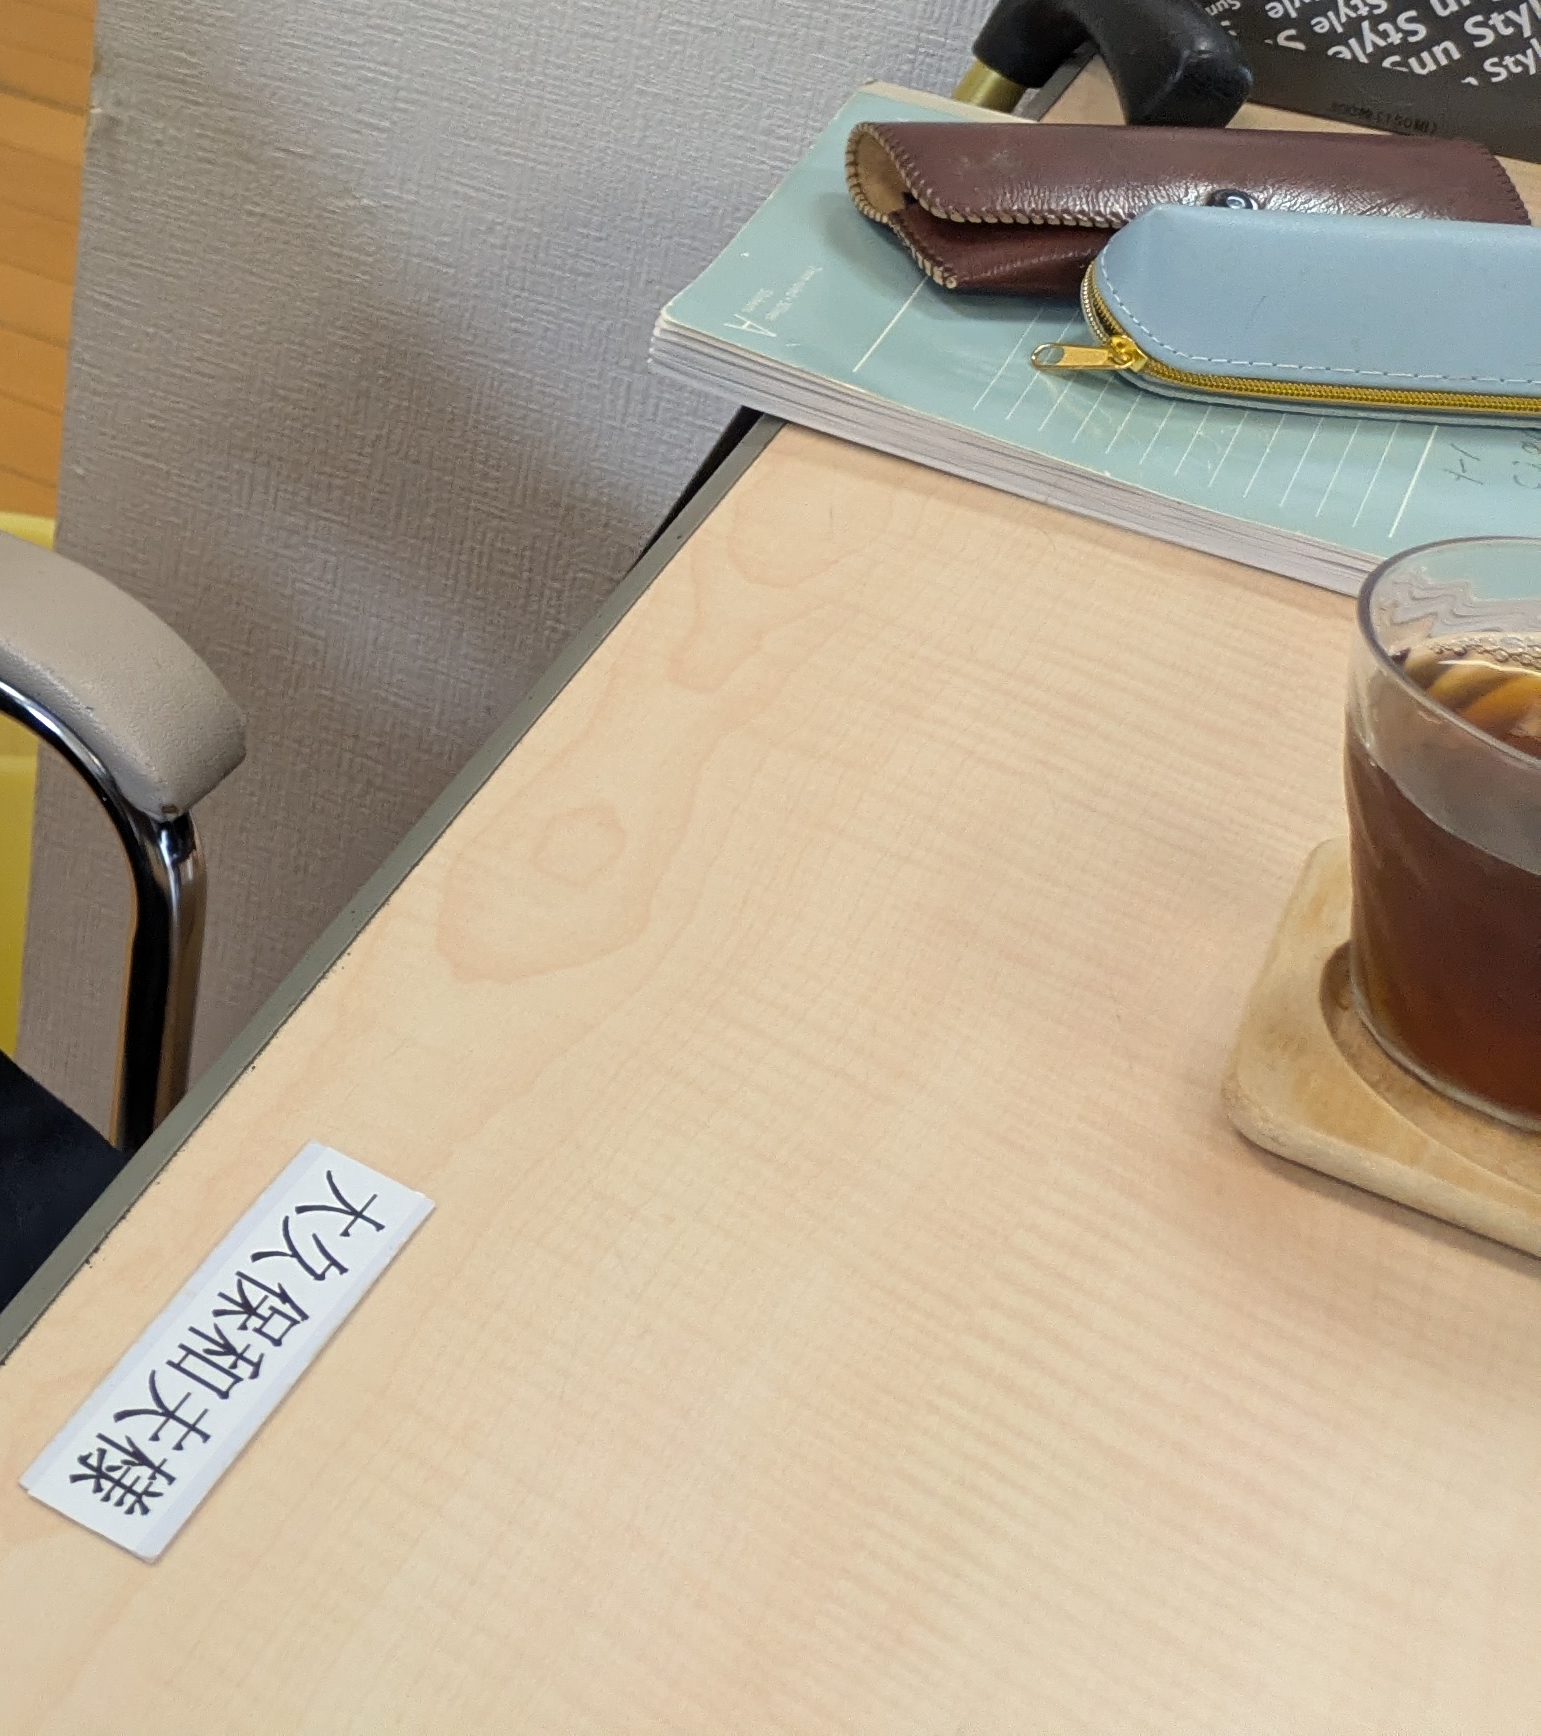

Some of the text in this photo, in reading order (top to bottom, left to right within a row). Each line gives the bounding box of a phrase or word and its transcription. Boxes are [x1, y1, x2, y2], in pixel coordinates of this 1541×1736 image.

[69, 1169, 386, 1517] 大久保和夫様
